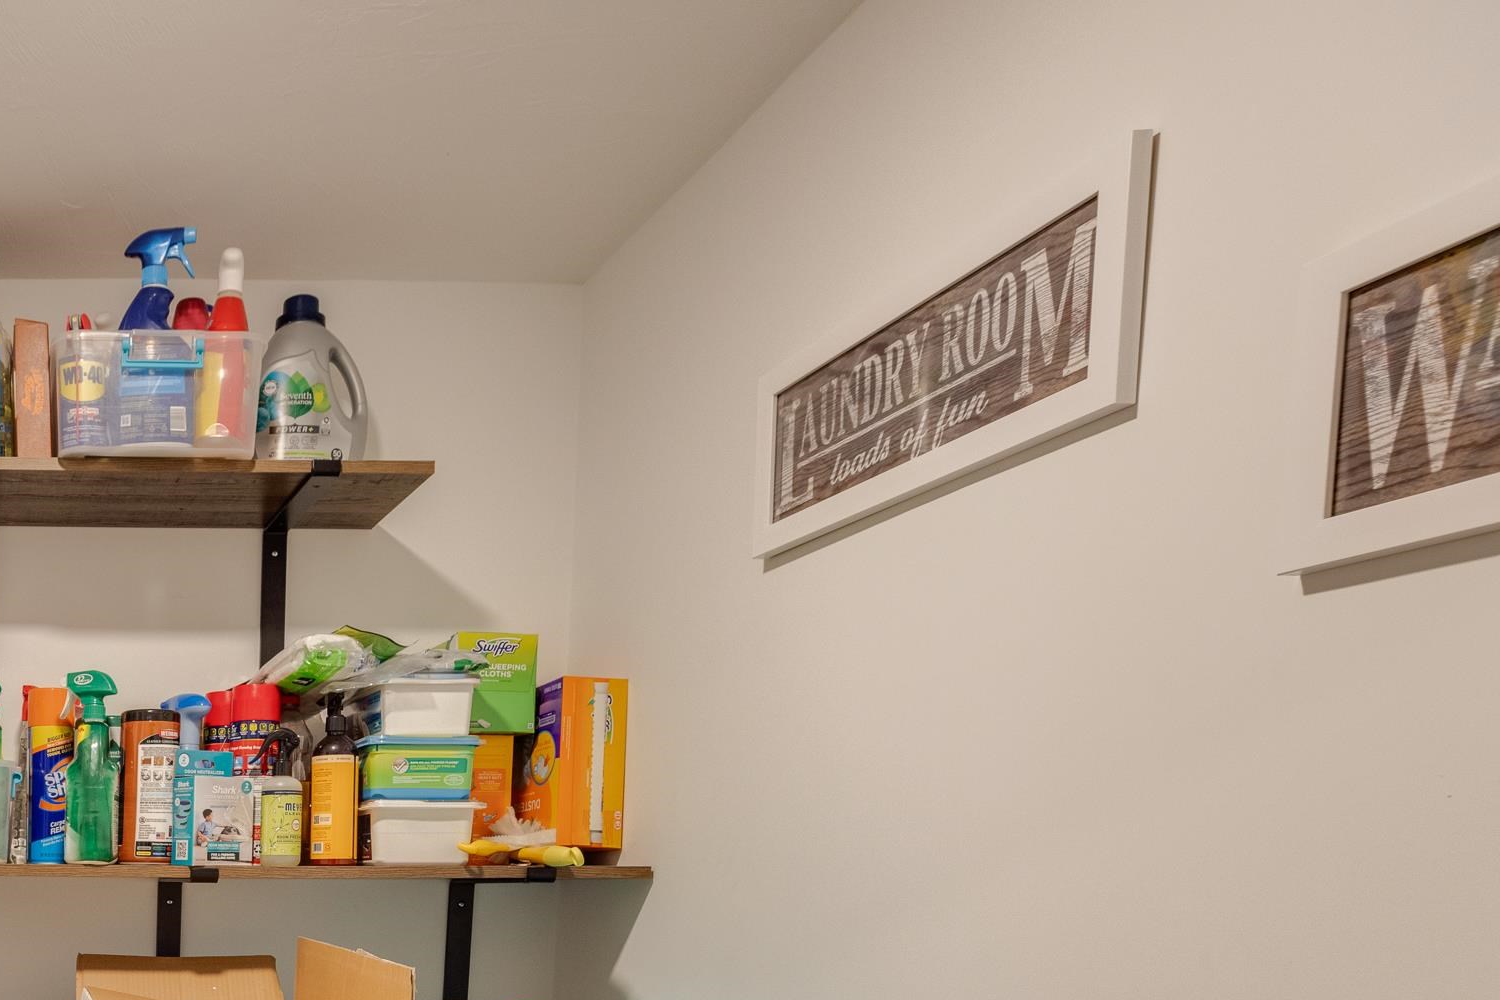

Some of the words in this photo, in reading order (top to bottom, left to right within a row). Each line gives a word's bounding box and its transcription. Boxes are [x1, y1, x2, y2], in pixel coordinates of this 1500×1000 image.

[775, 321, 930, 517] LAUNDRY
[939, 217, 1098, 401] ROOM
[1352, 254, 1500, 490] W
[829, 433, 891, 486] loads
[900, 410, 927, 461] of
[932, 389, 989, 451] fun
[472, 639, 518, 656] Swiffer
[479, 670, 512, 678] CLOTHS
[212, 784, 237, 794] Shark
